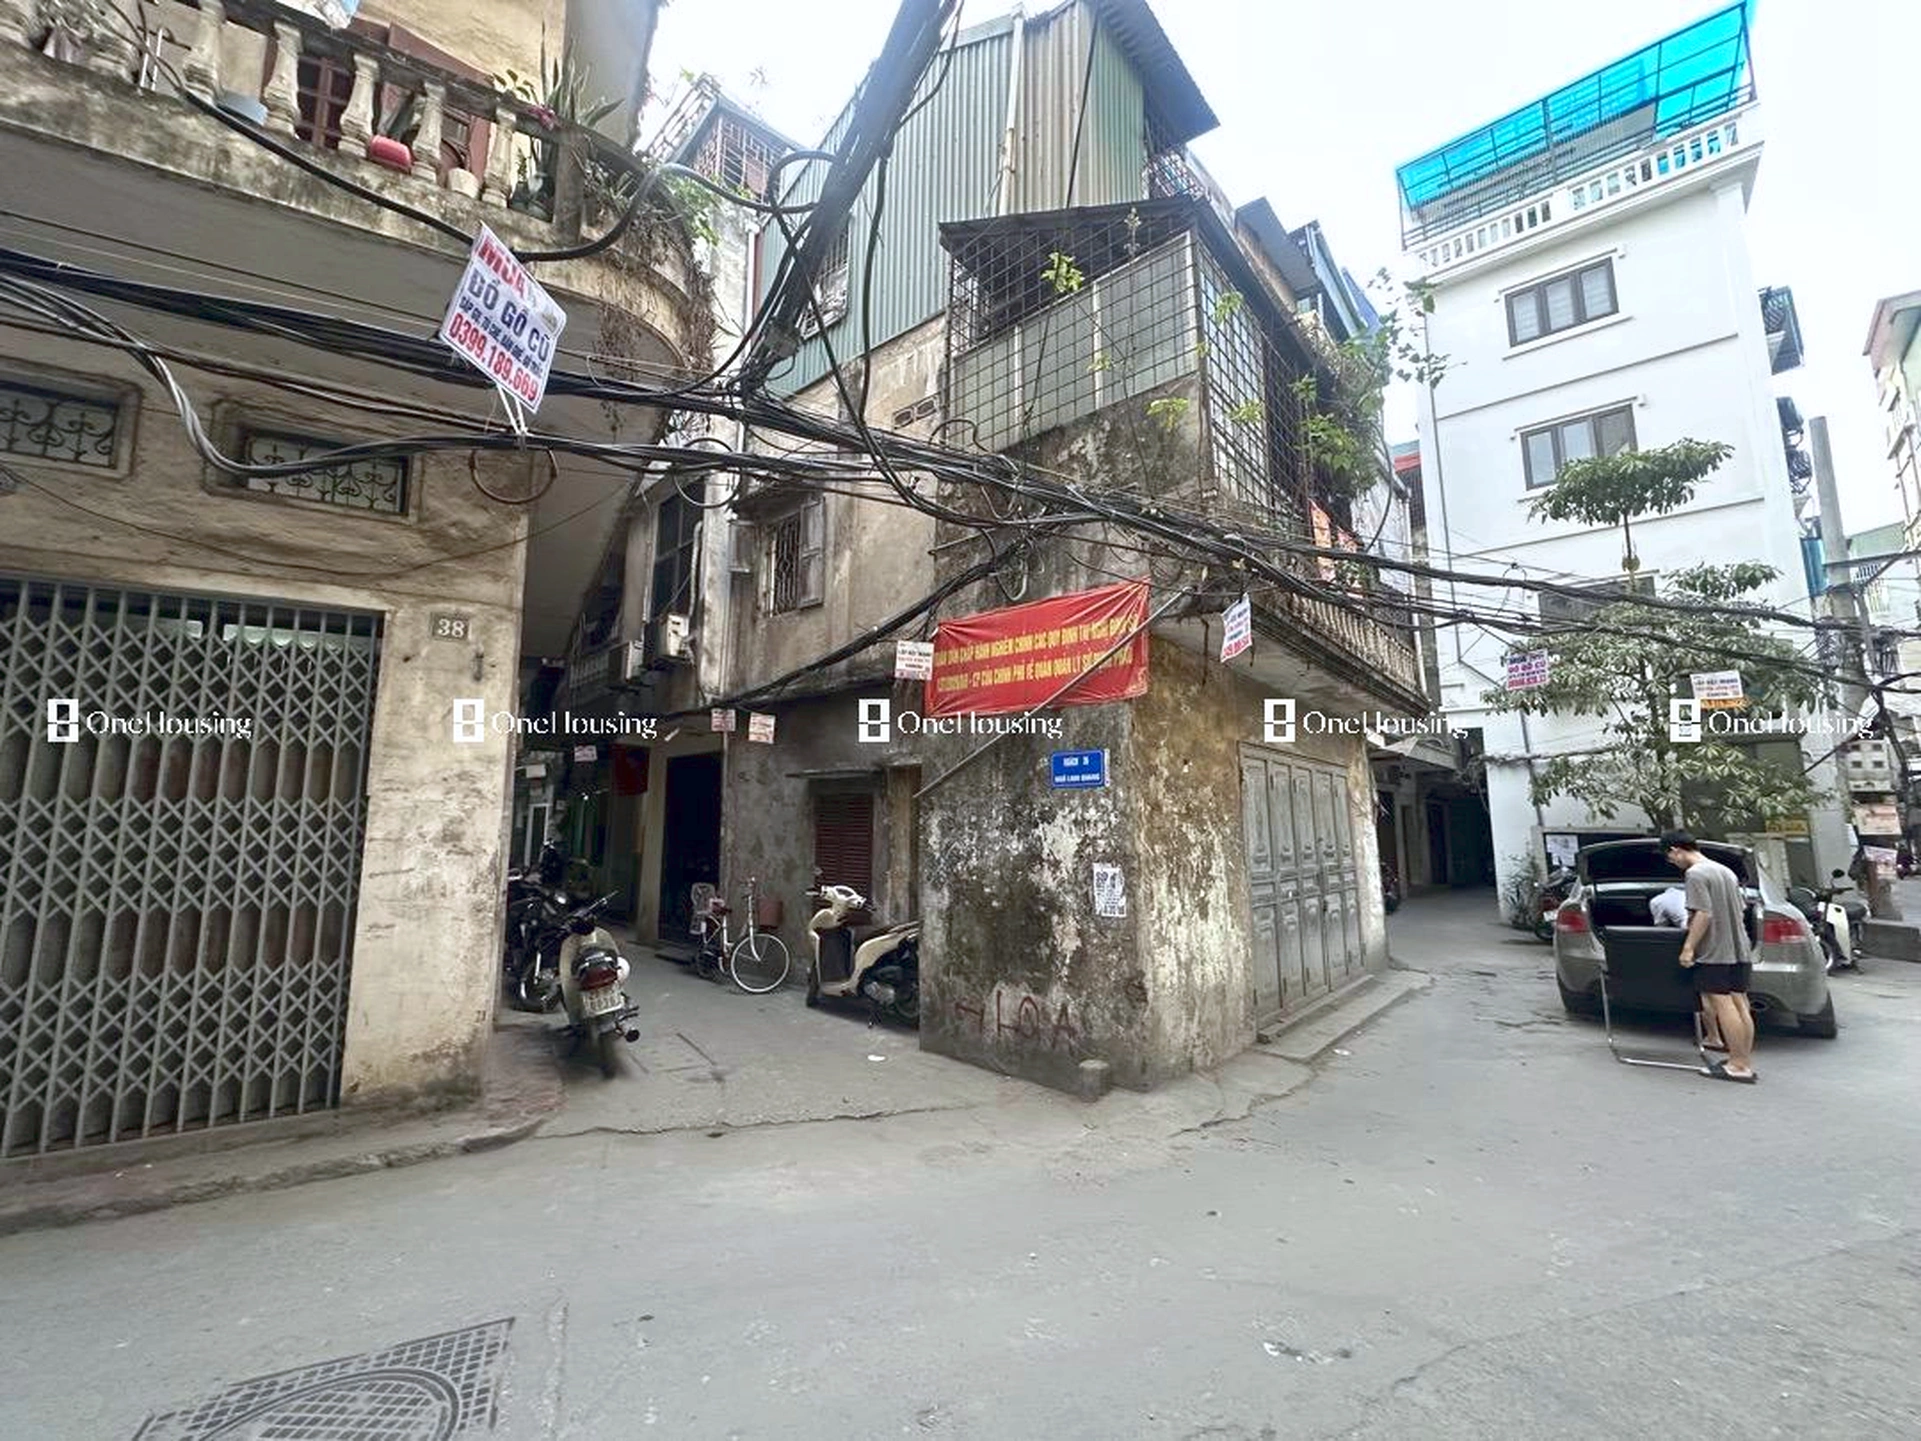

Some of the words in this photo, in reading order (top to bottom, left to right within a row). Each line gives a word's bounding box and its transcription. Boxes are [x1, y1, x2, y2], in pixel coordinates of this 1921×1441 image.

[500, 302, 529, 337] GỖ
[528, 327, 552, 363] CŨ
[438, 618, 465, 638] 38
